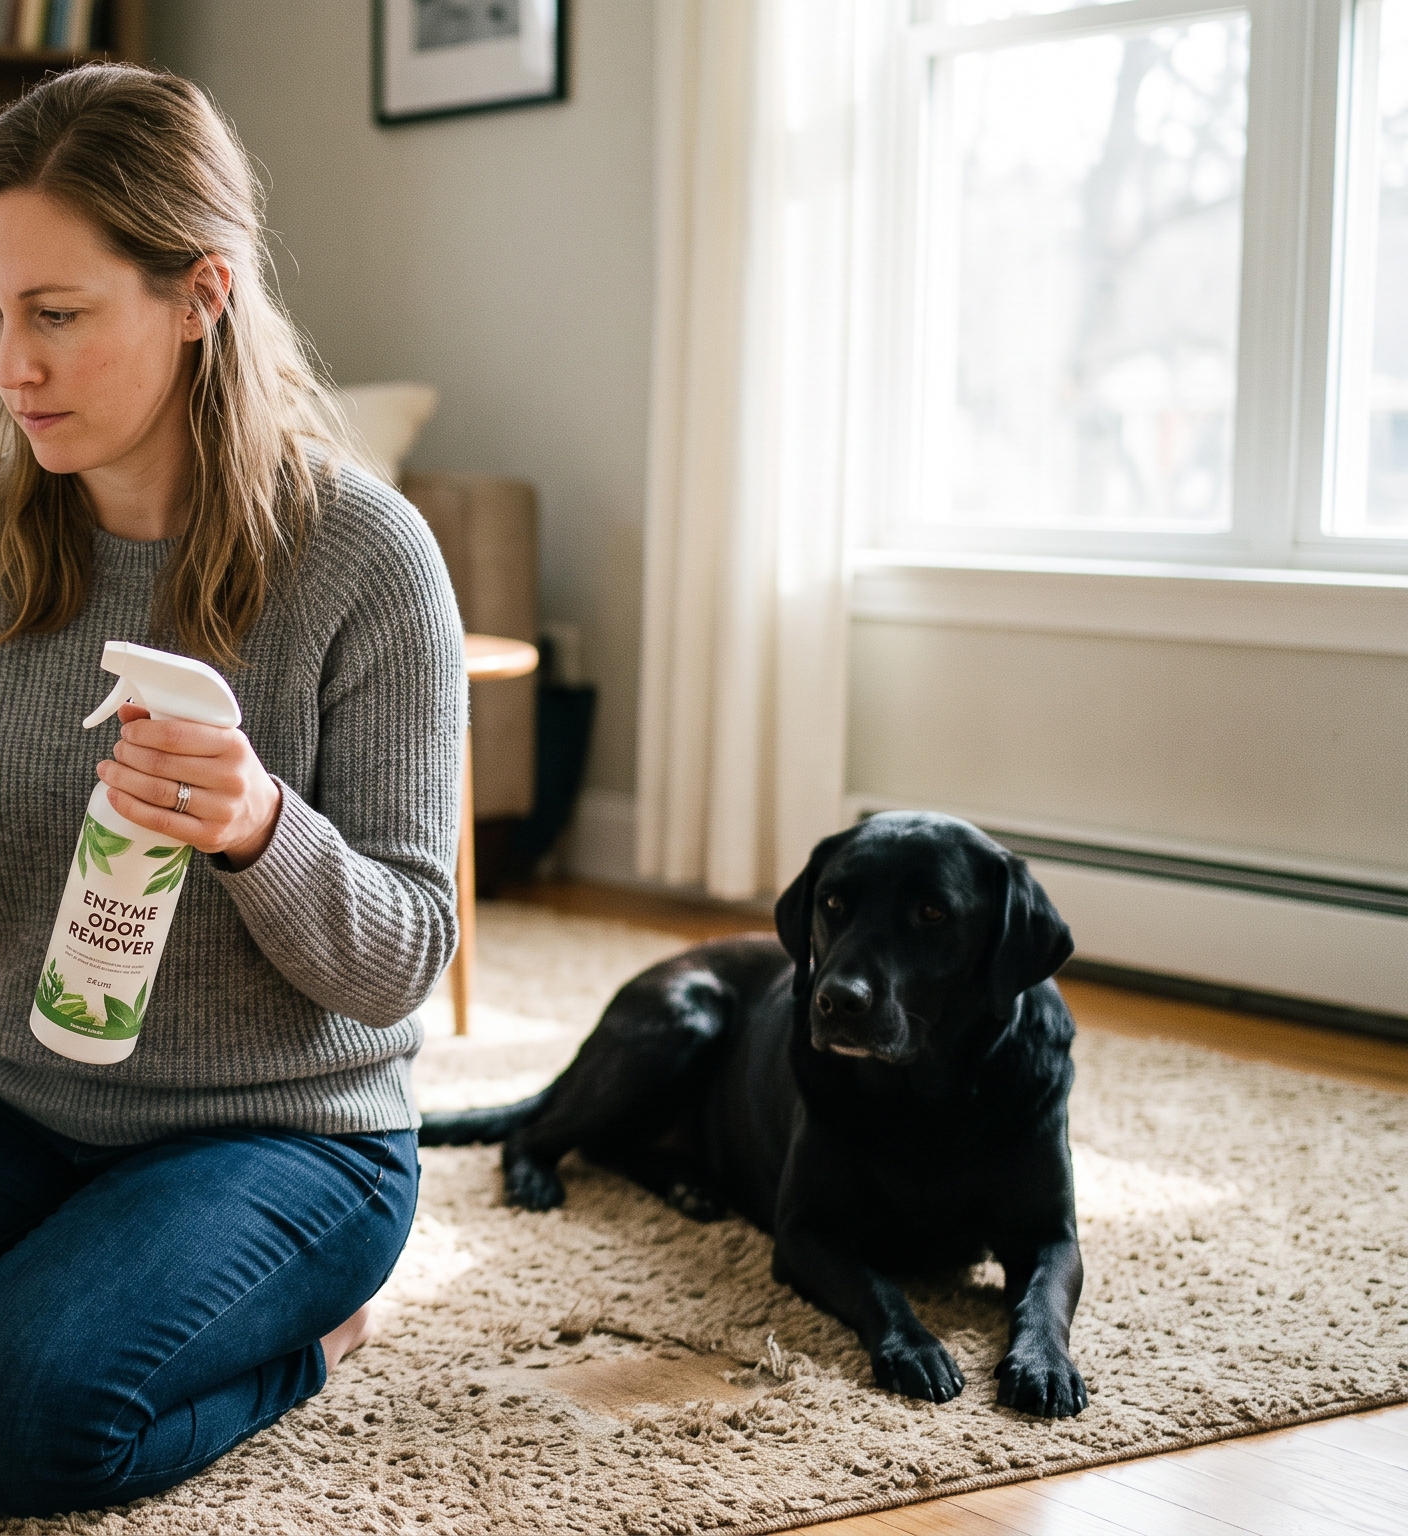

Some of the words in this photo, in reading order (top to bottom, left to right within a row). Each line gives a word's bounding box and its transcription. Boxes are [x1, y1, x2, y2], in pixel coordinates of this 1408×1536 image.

[83, 889, 158, 920] ENZYME
[68, 920, 154, 955] REMOVER
[88, 912, 145, 938] ODOR
